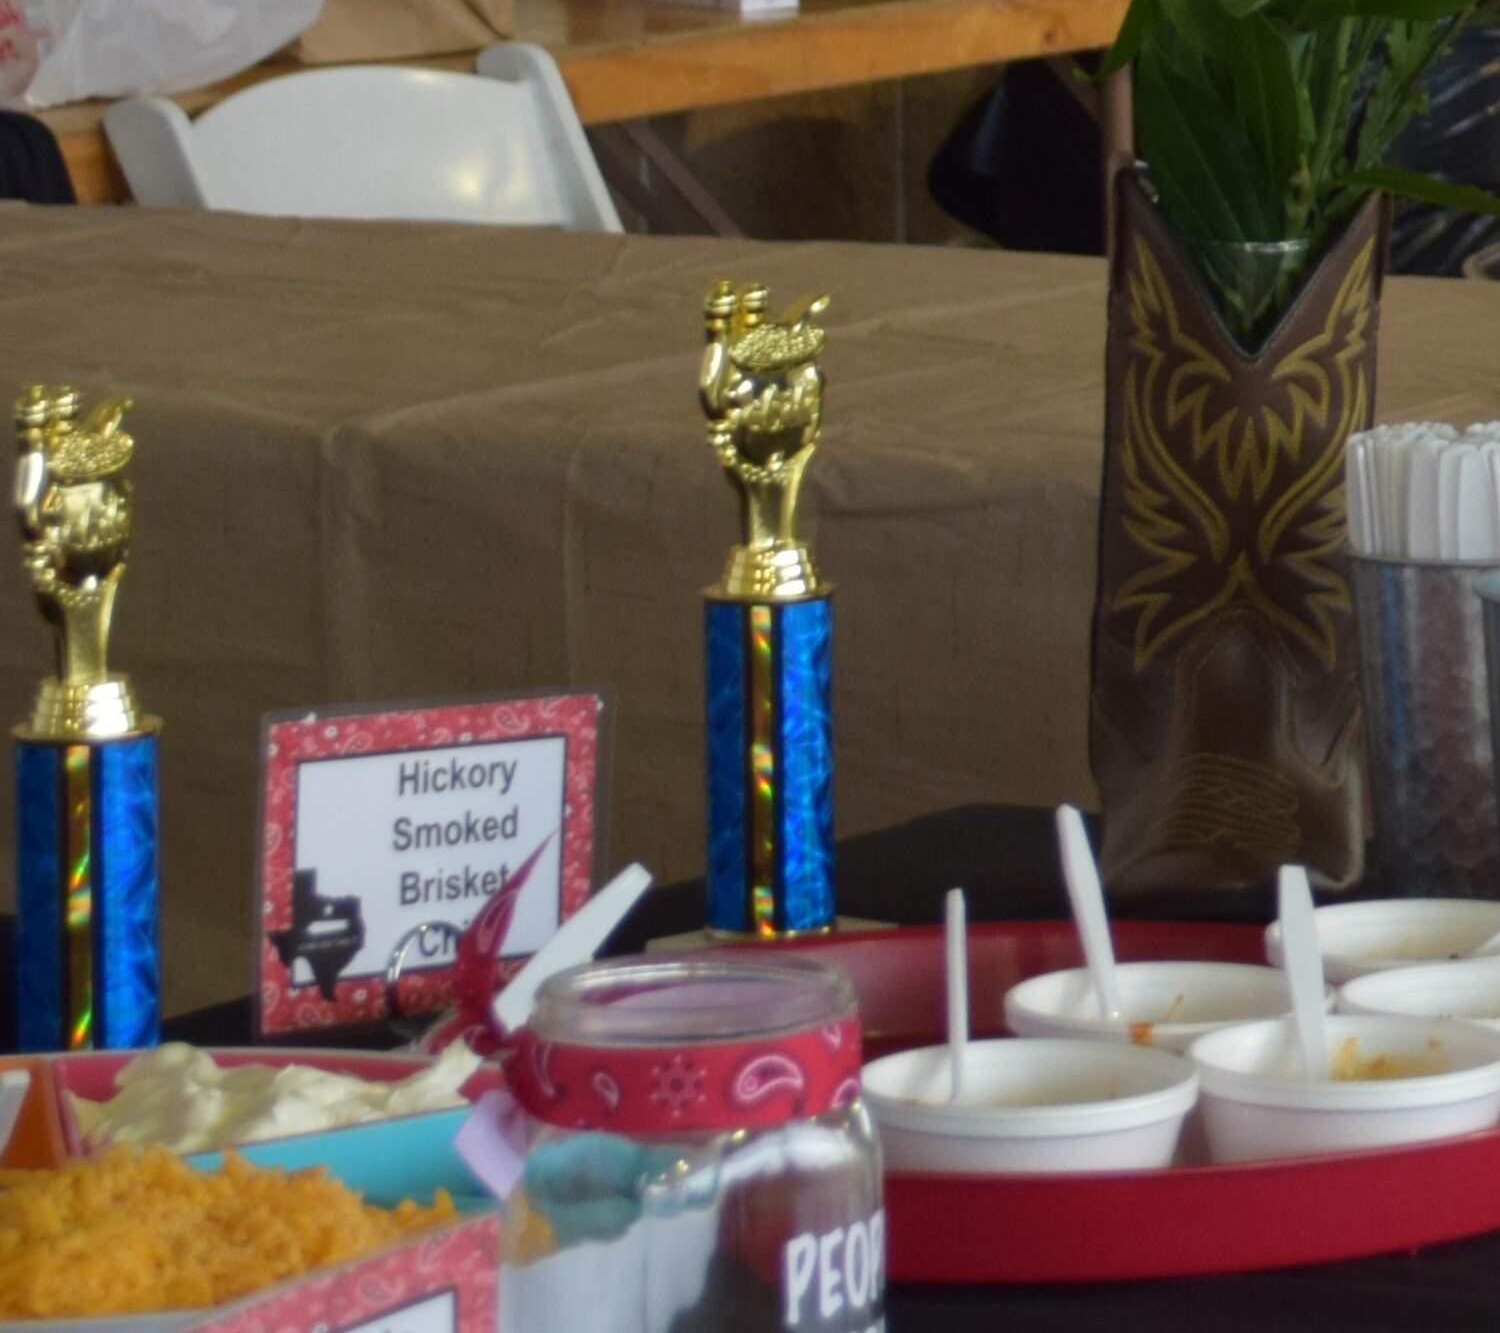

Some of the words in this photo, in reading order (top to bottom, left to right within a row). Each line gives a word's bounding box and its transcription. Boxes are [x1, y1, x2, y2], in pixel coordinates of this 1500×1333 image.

[398, 758, 518, 797] Hickory
[392, 806, 518, 852] Smoked
[399, 863, 510, 907] Brisket
